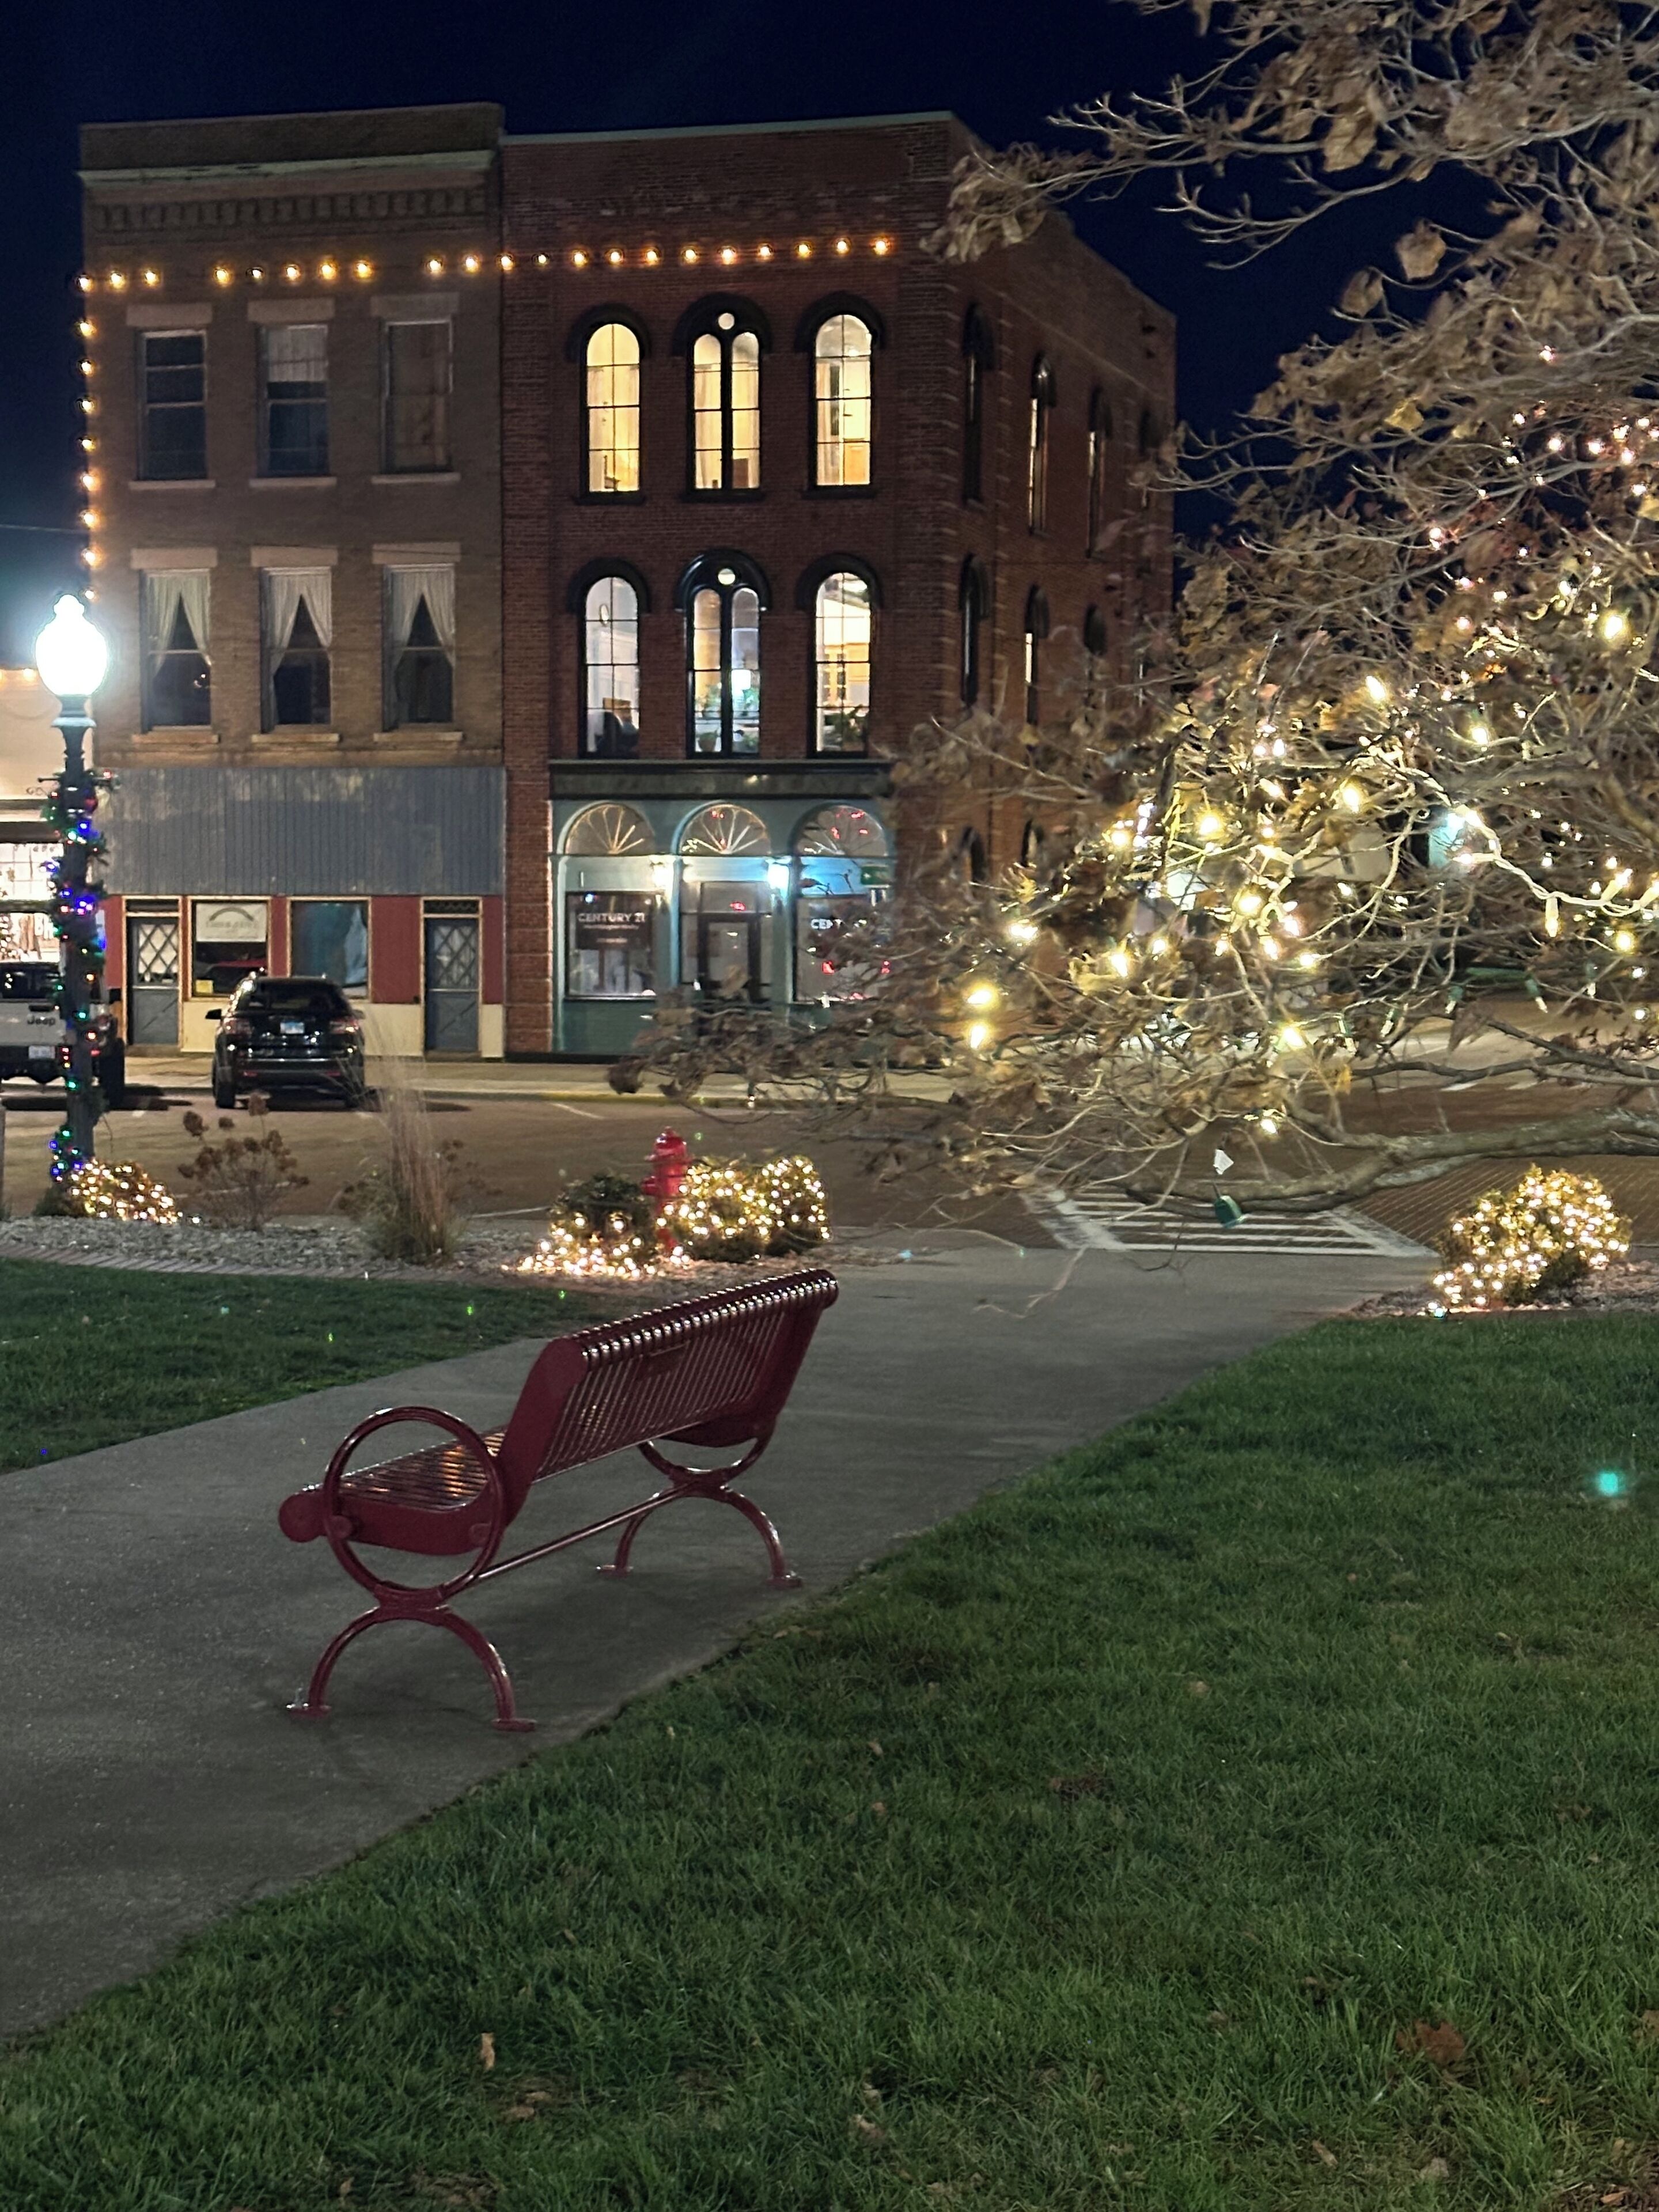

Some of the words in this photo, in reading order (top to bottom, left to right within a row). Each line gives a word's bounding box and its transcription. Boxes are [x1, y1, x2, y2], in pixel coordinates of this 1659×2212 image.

[578, 912, 632, 922] CENTURY
[634, 912, 645, 922] 21
[27, 1016, 55, 1026] Jeep
